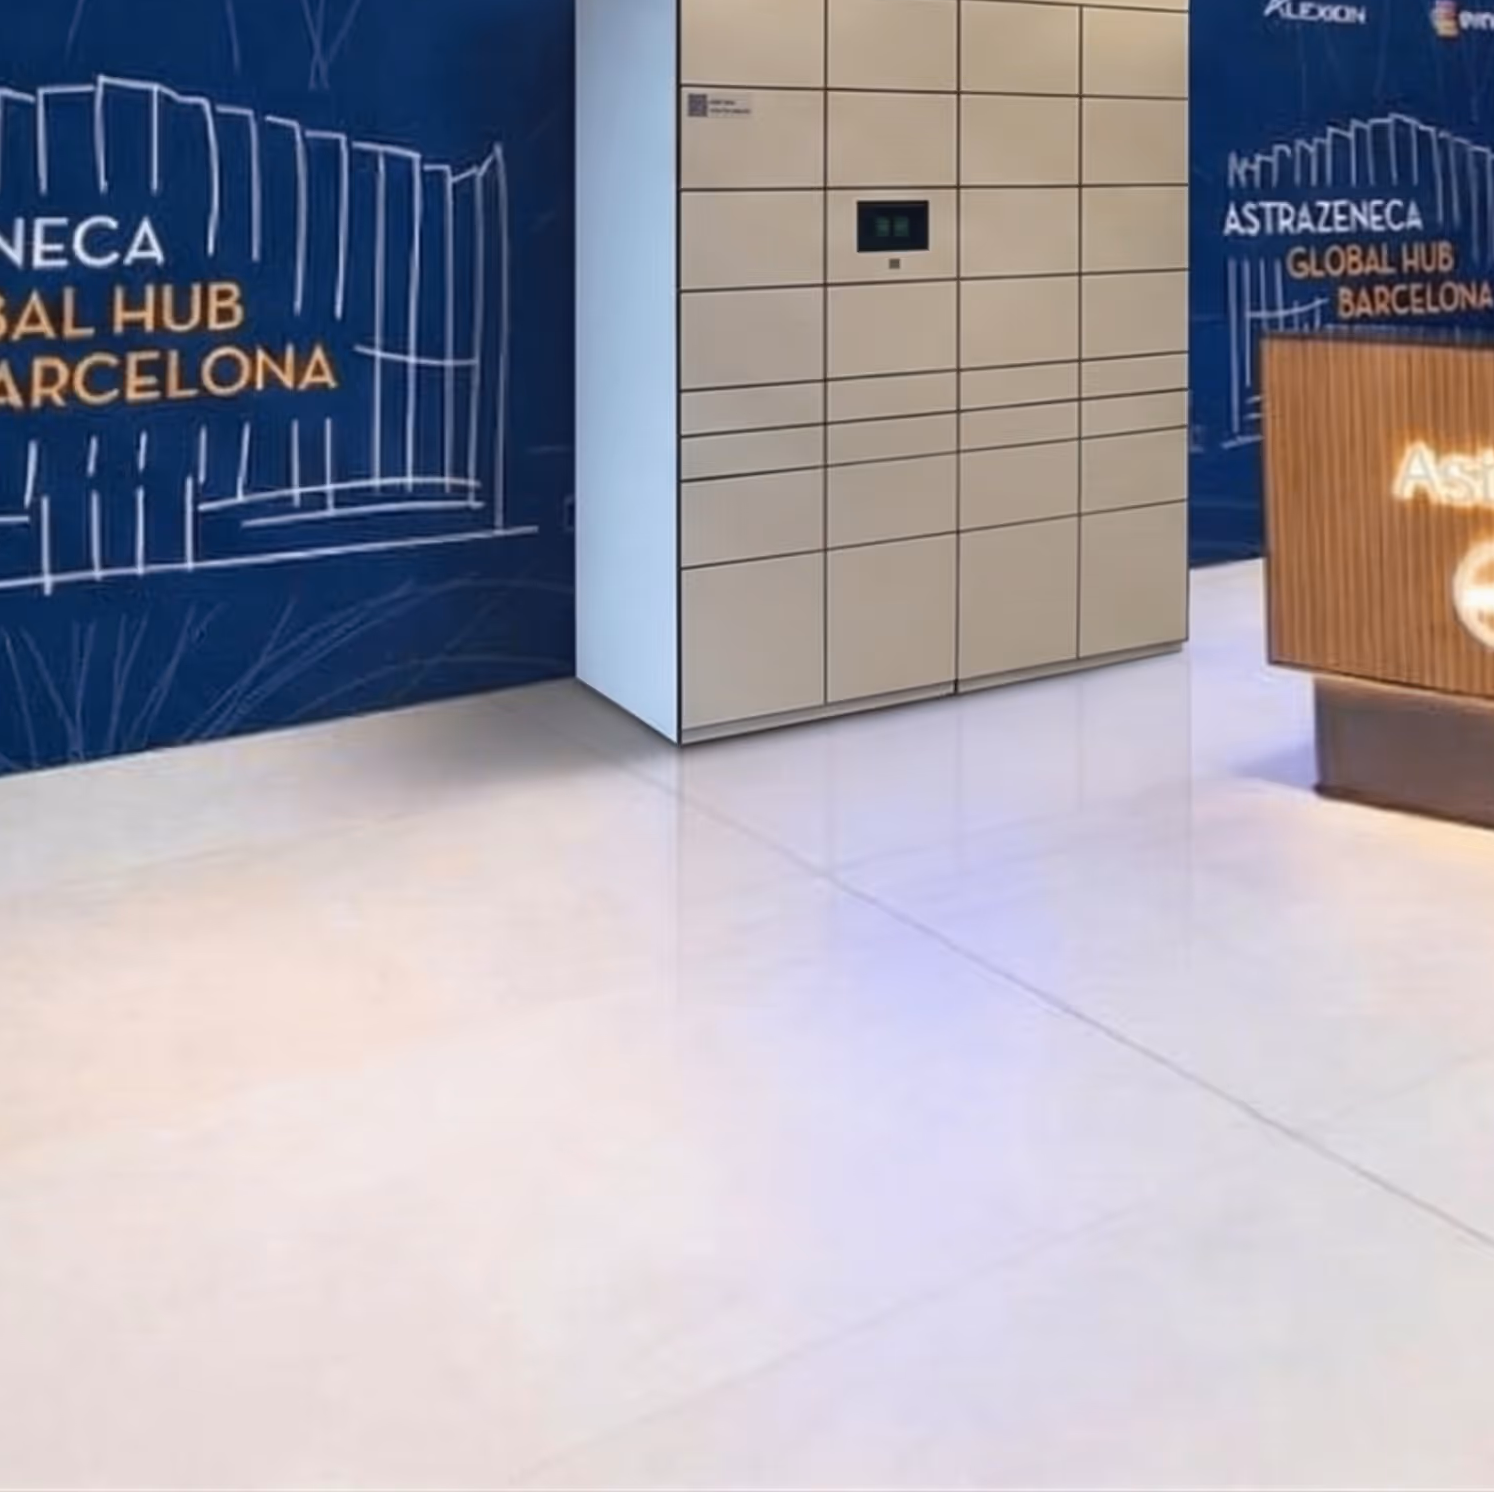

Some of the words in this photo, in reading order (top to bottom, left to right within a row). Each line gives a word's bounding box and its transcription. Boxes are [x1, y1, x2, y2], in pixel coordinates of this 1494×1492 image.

[1223, 199, 1423, 236] ASTRAZENECA
[1285, 243, 1394, 279] GLOBAL
[1402, 241, 1455, 272] HUB
[112, 281, 245, 336] HUB
[1337, 280, 1494, 320] BARCELONA
